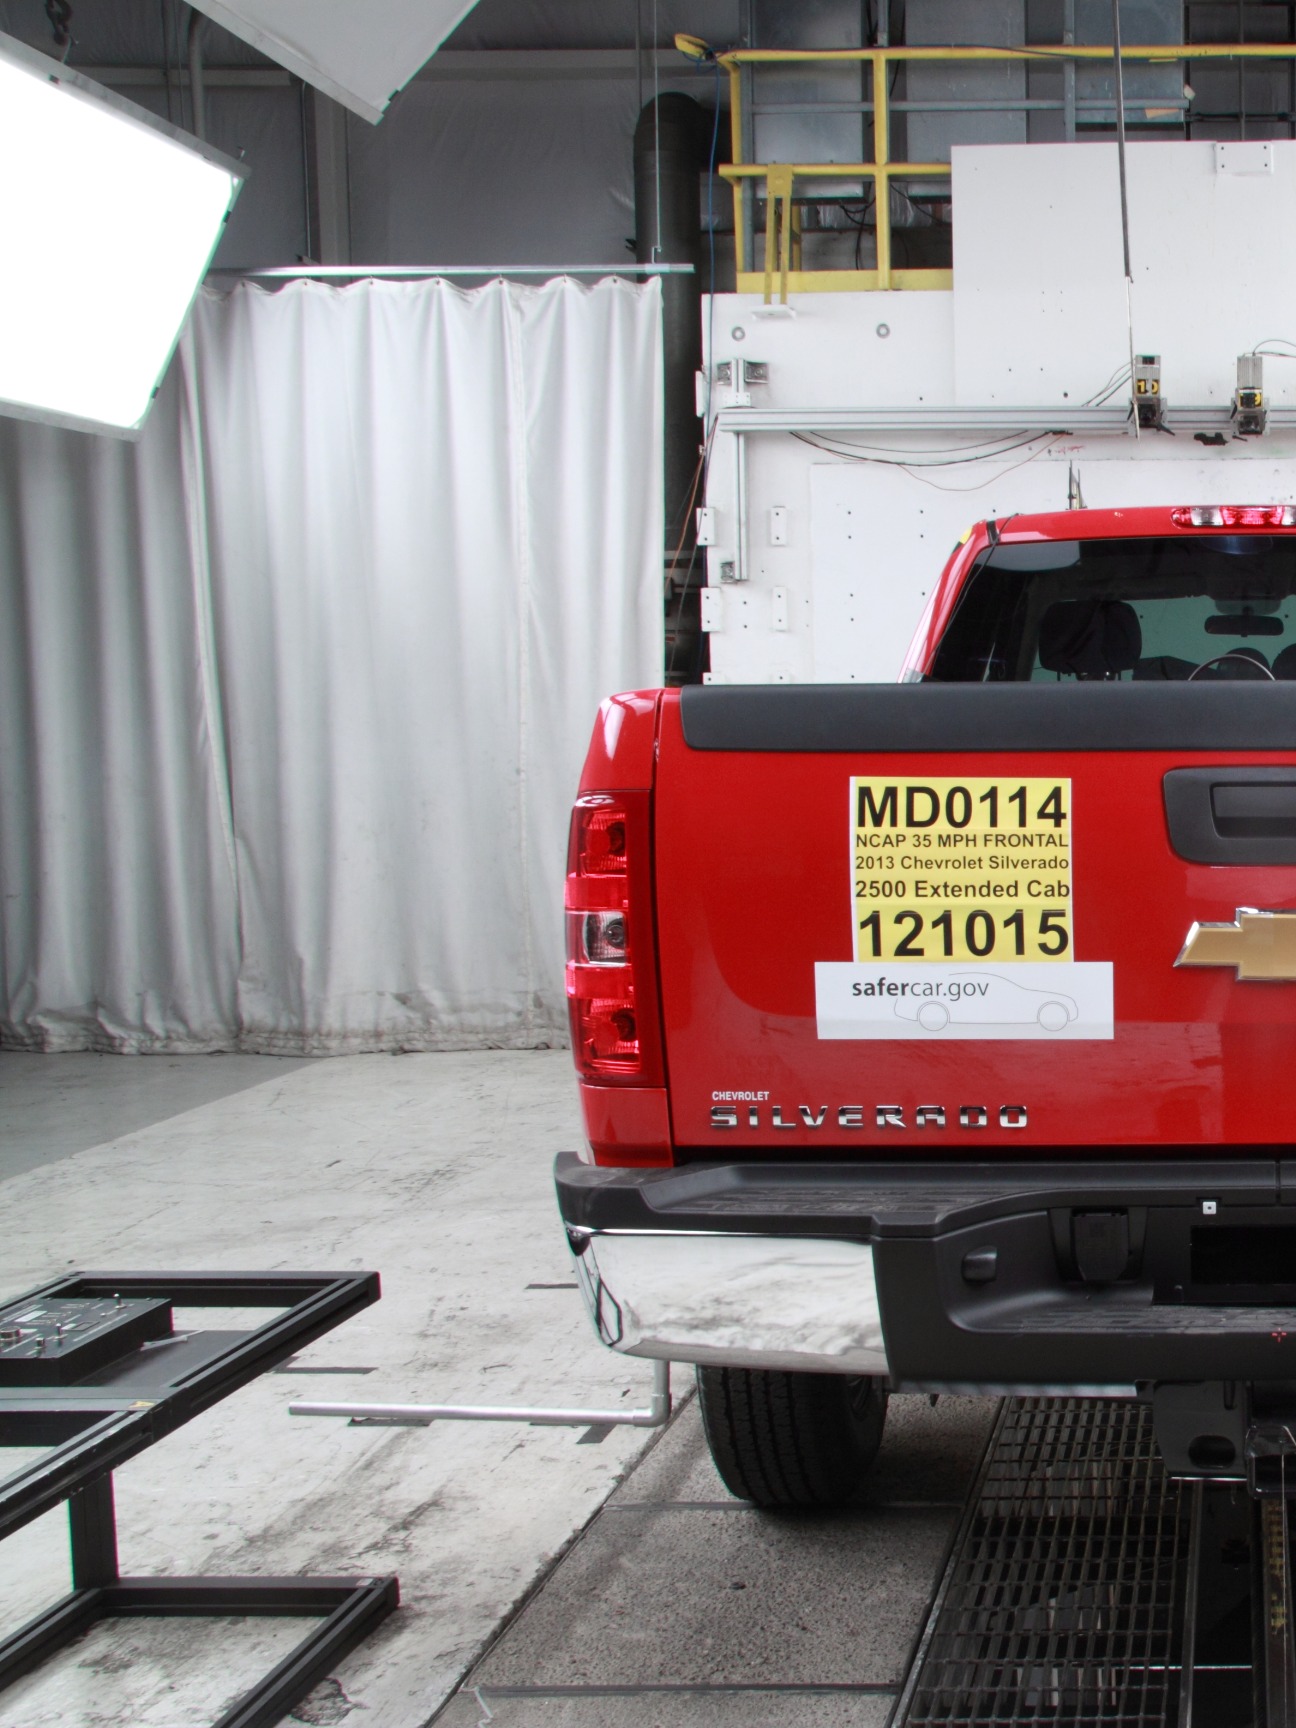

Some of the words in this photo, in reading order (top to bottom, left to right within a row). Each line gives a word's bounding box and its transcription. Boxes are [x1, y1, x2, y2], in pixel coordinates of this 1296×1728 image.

[857, 785, 1067, 829] MD0114
[856, 834, 907, 848] NCAP
[912, 834, 932, 848] 35
[938, 834, 977, 848] MPH
[984, 834, 1069, 848] FRONTAL
[855, 856, 895, 870] 2013
[900, 856, 983, 870] Chevrolet
[989, 856, 1070, 870] Silverado
[855, 880, 907, 898] 2500
[915, 880, 1019, 898] Extended
[1027, 880, 1071, 898] Cab
[859, 909, 1069, 957] 121015
[852, 977, 989, 1002] safercar.gov
[712, 1091, 769, 1101] CHEVROLET
[711, 1105, 1028, 1128] SILVERADO
